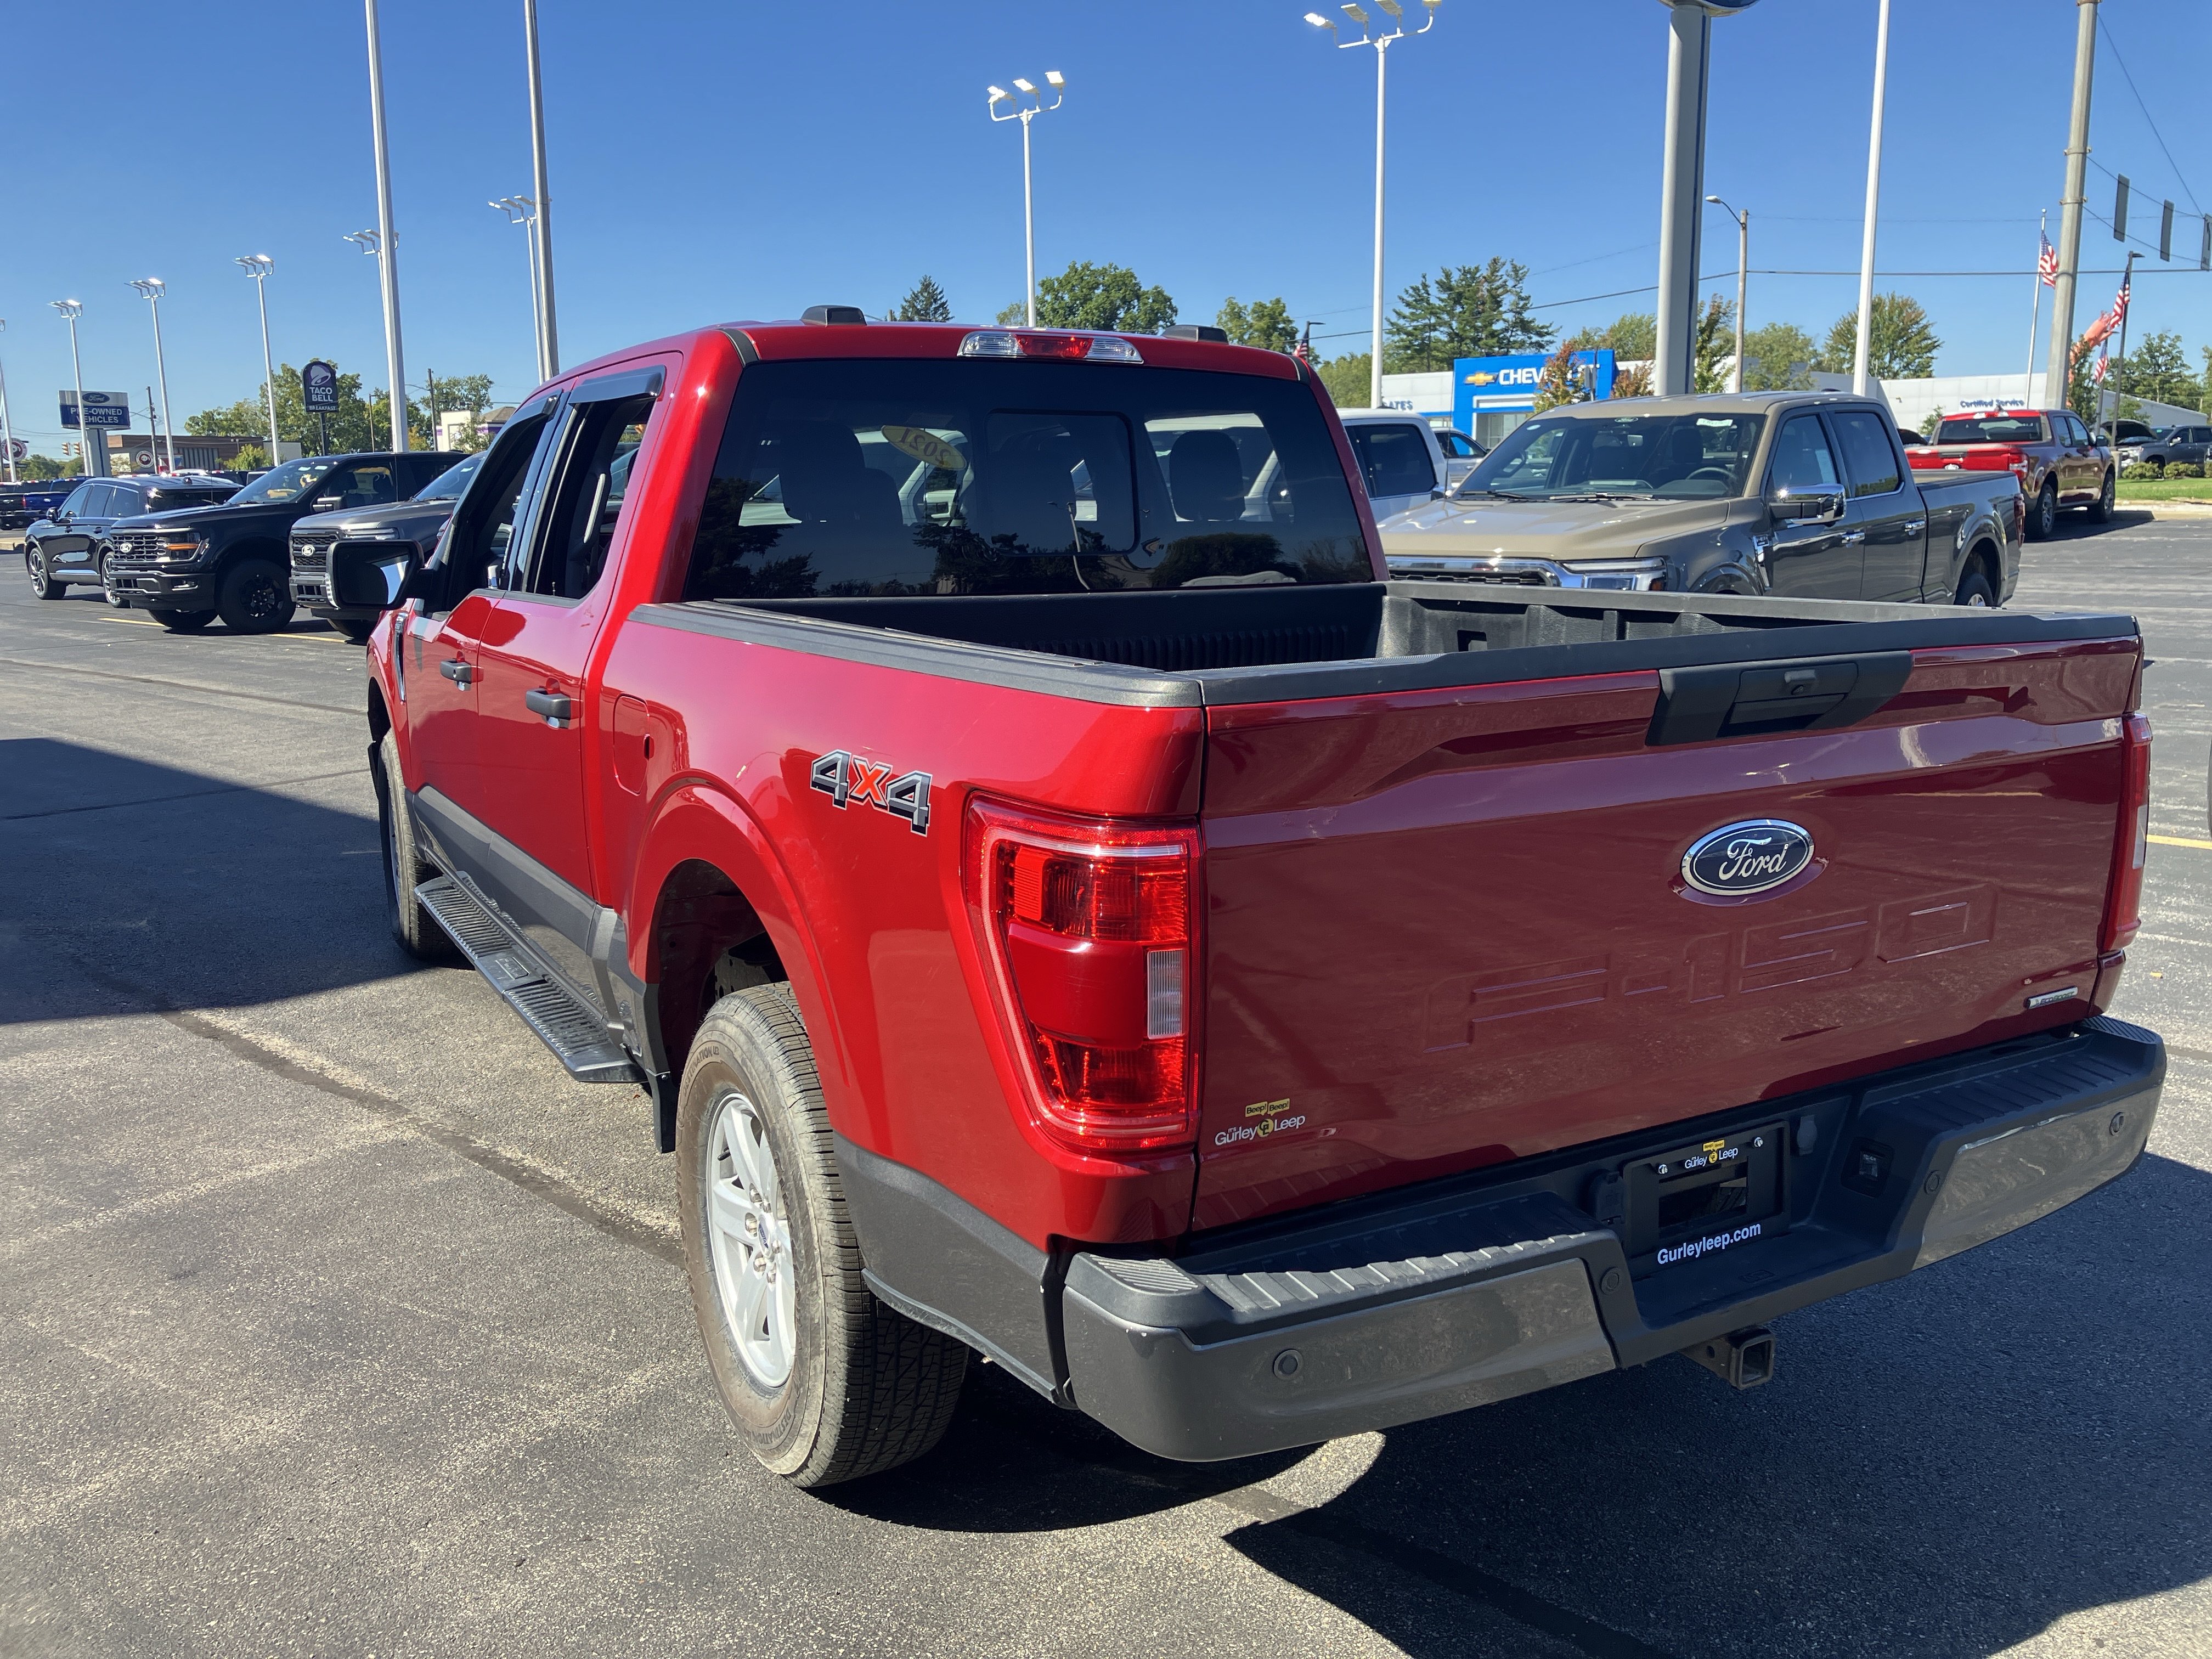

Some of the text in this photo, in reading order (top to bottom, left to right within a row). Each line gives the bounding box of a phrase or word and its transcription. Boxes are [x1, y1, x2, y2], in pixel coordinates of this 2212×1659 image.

[1718, 837, 1789, 881] Ford
[1246, 1101, 1289, 1114] Beep! Beep!
[1215, 1126, 1258, 1146] Gurley
[1274, 1115, 1306, 1131] Leep
[1685, 1156, 1707, 1169] Gurley
[1719, 1148, 1738, 1160] Leep
[1657, 1223, 1761, 1265] Gurleyleep.com
